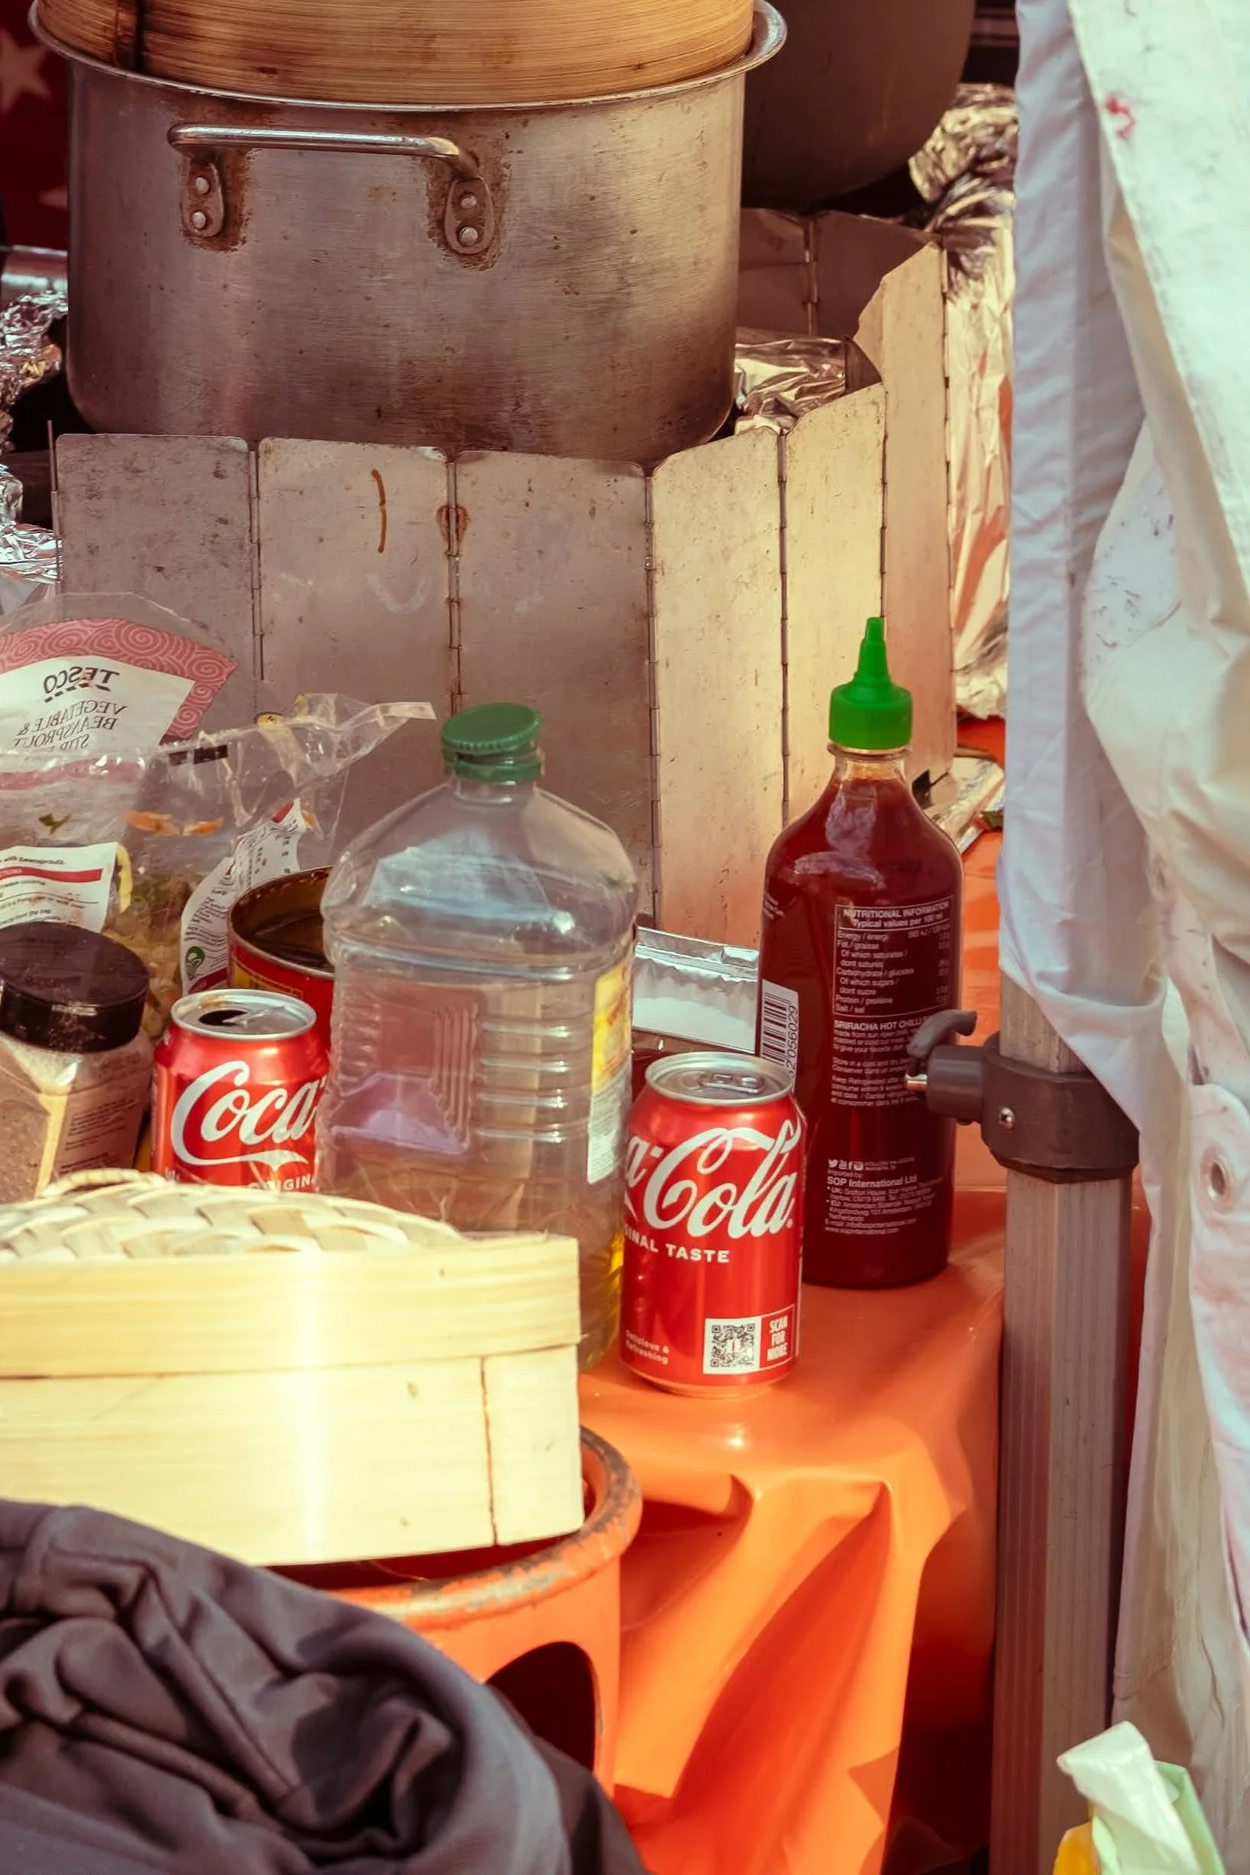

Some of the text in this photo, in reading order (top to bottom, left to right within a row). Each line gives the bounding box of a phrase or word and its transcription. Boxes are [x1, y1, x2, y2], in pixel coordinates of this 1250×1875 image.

[844, 902, 949, 918] NUTRITIONAL INFORMATION
[853, 919, 882, 928] Typical
[884, 919, 908, 927] values
[910, 917, 922, 926] per
[834, 1020, 878, 1031] SRIRACHA
[880, 1022, 896, 1030] HOT
[827, 1175, 917, 1187] SOP International Ltd
[666, 1243, 730, 1264] TASTE
[769, 1315, 788, 1334] SCAN
[771, 1331, 787, 1345] FOR
[766, 1342, 788, 1361] MORE
